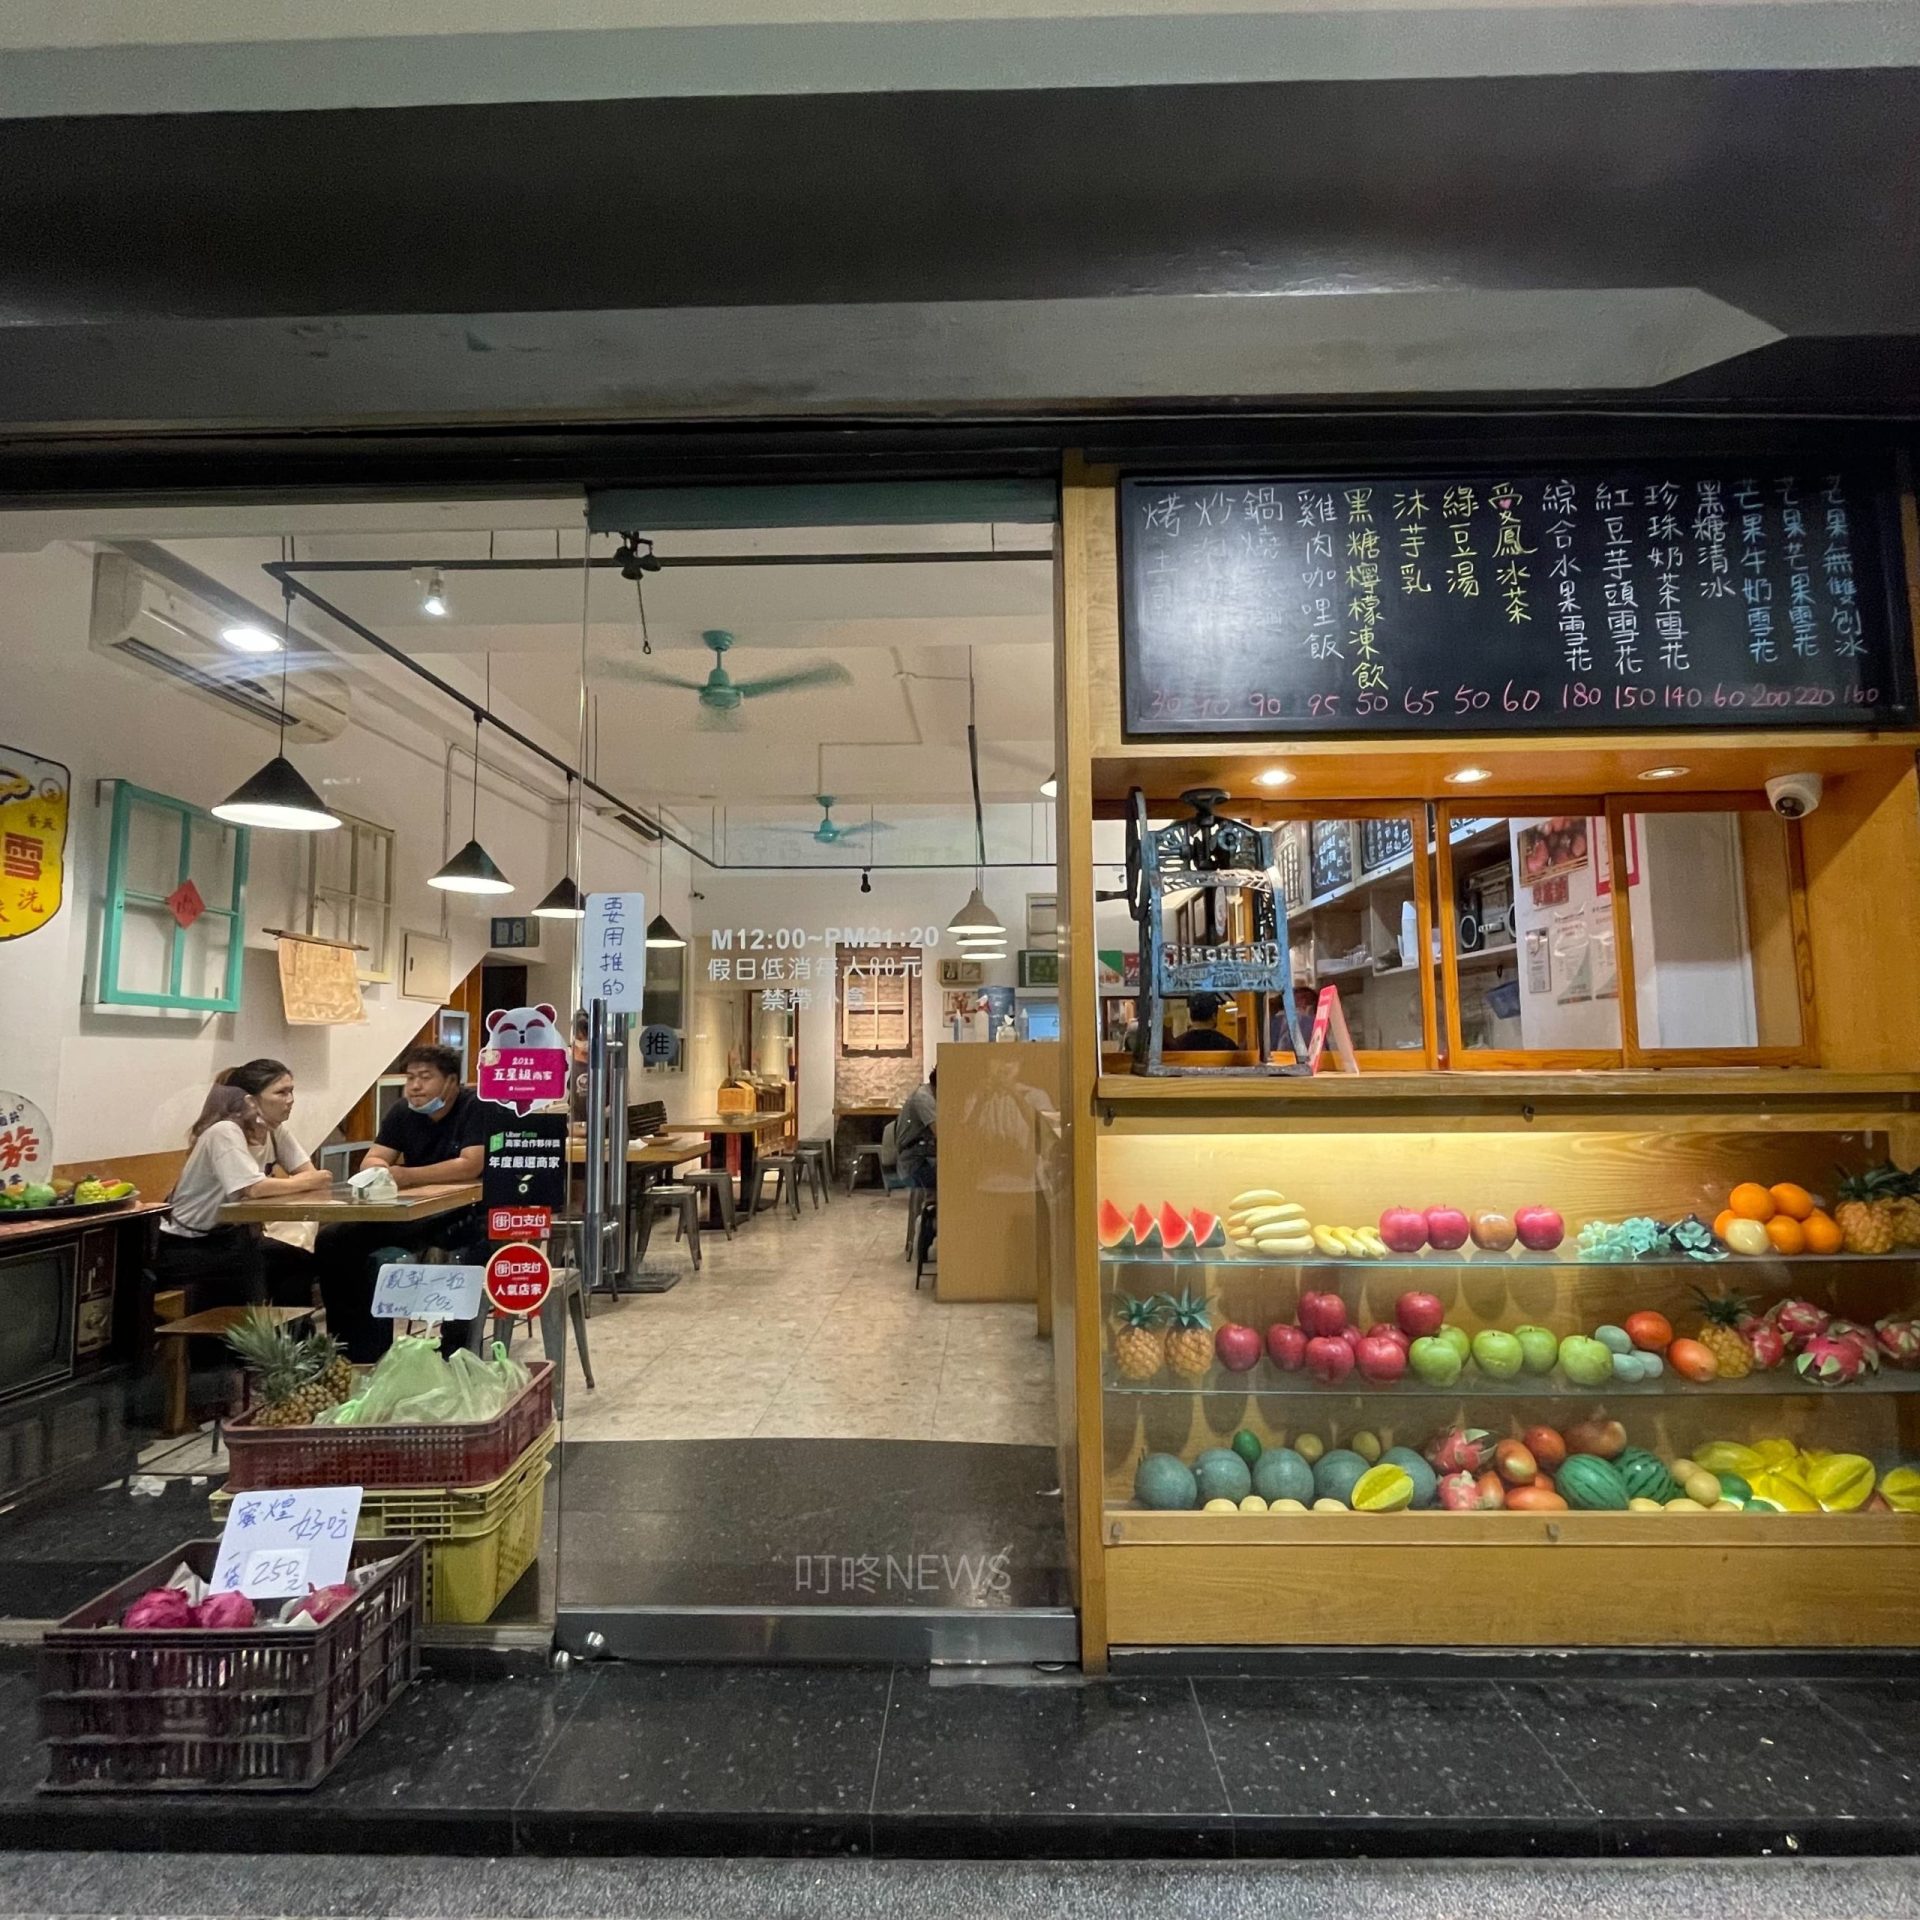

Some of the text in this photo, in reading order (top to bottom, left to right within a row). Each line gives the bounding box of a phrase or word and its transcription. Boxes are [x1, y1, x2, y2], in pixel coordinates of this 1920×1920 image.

[1296, 489, 1345, 660] 雞肉咖哩飯
[1343, 487, 1389, 691] 黑糖檸檬凍飲
[1442, 485, 1480, 599] 綠豆湯
[1541, 478, 1593, 672] 綜合水果雪花
[1595, 481, 1644, 676] 紅豆芋頭雪花
[1644, 480, 1691, 671] 珍珠奶茶雪花
[1691, 479, 1737, 599] 黑糖清冰
[1733, 477, 1779, 664] 芒果牛奶雪花
[1774, 475, 1821, 657] 芒果芒果雪花
[1820, 474, 1869, 657] 芒果無雙刨冰
[1249, 692, 1281, 717] 90
[1307, 693, 1340, 716] 95
[1355, 691, 1389, 715] 50
[1404, 686, 1440, 715] 65
[1454, 684, 1491, 714] 50
[1502, 680, 1541, 712] 60
[1562, 682, 1602, 709] 180
[1614, 685, 1656, 709] 150
[1664, 684, 1702, 708] 140
[1713, 682, 1746, 708] 60
[1751, 682, 1792, 707] 200
[1794, 686, 1836, 706] 220
[1844, 684, 1880, 704] 160
[599, 896, 626, 997] 要用推的
[493, 1067, 553, 1081] 五星級商家
[645, 1032, 670, 1055] 推
[489, 1156, 560, 1169] 年度嚴選商家
[493, 1212, 547, 1231] 街口支付
[495, 1261, 542, 1277] 街口支付
[495, 1283, 543, 1296] 人氣店家
